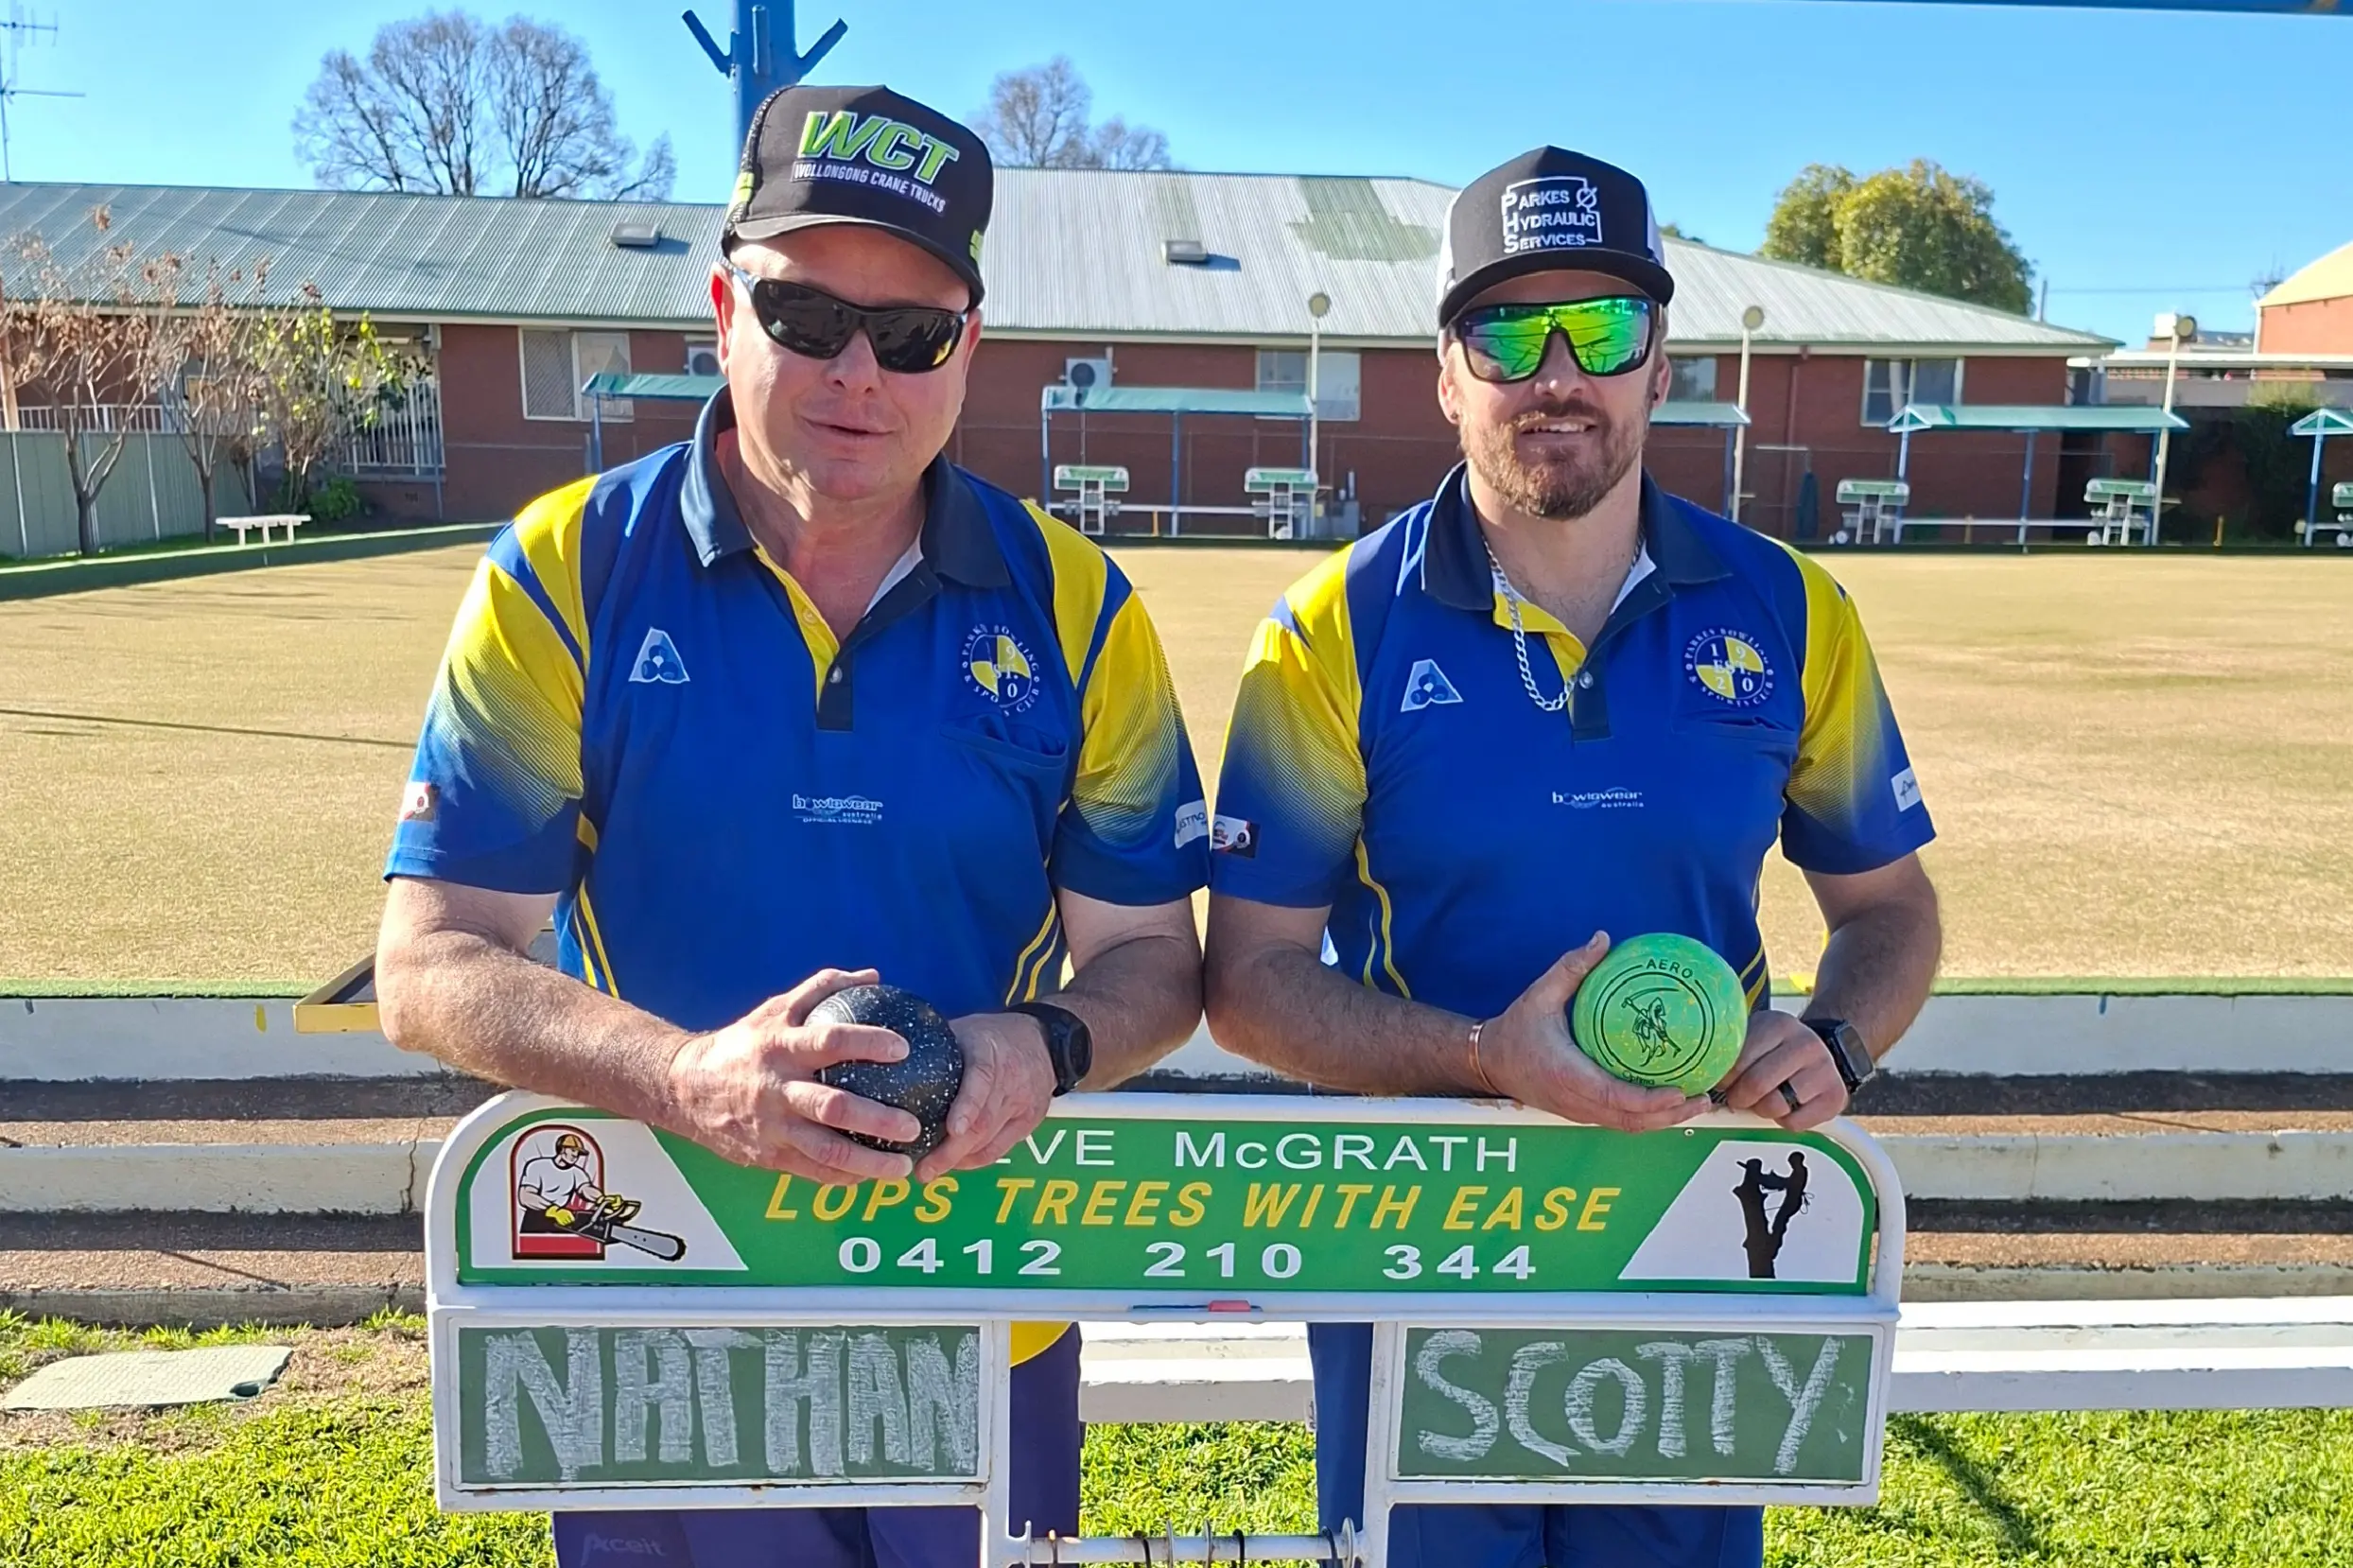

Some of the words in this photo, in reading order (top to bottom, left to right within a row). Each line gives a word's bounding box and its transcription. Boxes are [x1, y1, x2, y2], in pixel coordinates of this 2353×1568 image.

[797, 110, 959, 184] WCT
[793, 162, 868, 183] WOLLONGONG
[870, 171, 908, 195] CRANE
[909, 183, 946, 214] TRUCKS
[1502, 190, 1570, 217] PARKES
[1503, 211, 1596, 236] HYDRAULIC
[1504, 234, 1587, 253] SERVICES
[1646, 958, 1694, 979] AERO
[1175, 1131, 1517, 1172] McGRATH
[764, 1174, 959, 1224] LOPS
[995, 1176, 1212, 1228] TREES
[1244, 1183, 1422, 1229] WITH
[1442, 1186, 1622, 1231] EASE
[838, 1236, 1063, 1276] 0412
[1142, 1242, 1303, 1279] 210
[1382, 1245, 1537, 1281] 344
[483, 1325, 980, 1483] NATHAN
[1415, 1329, 1845, 1476] SCOTTY
